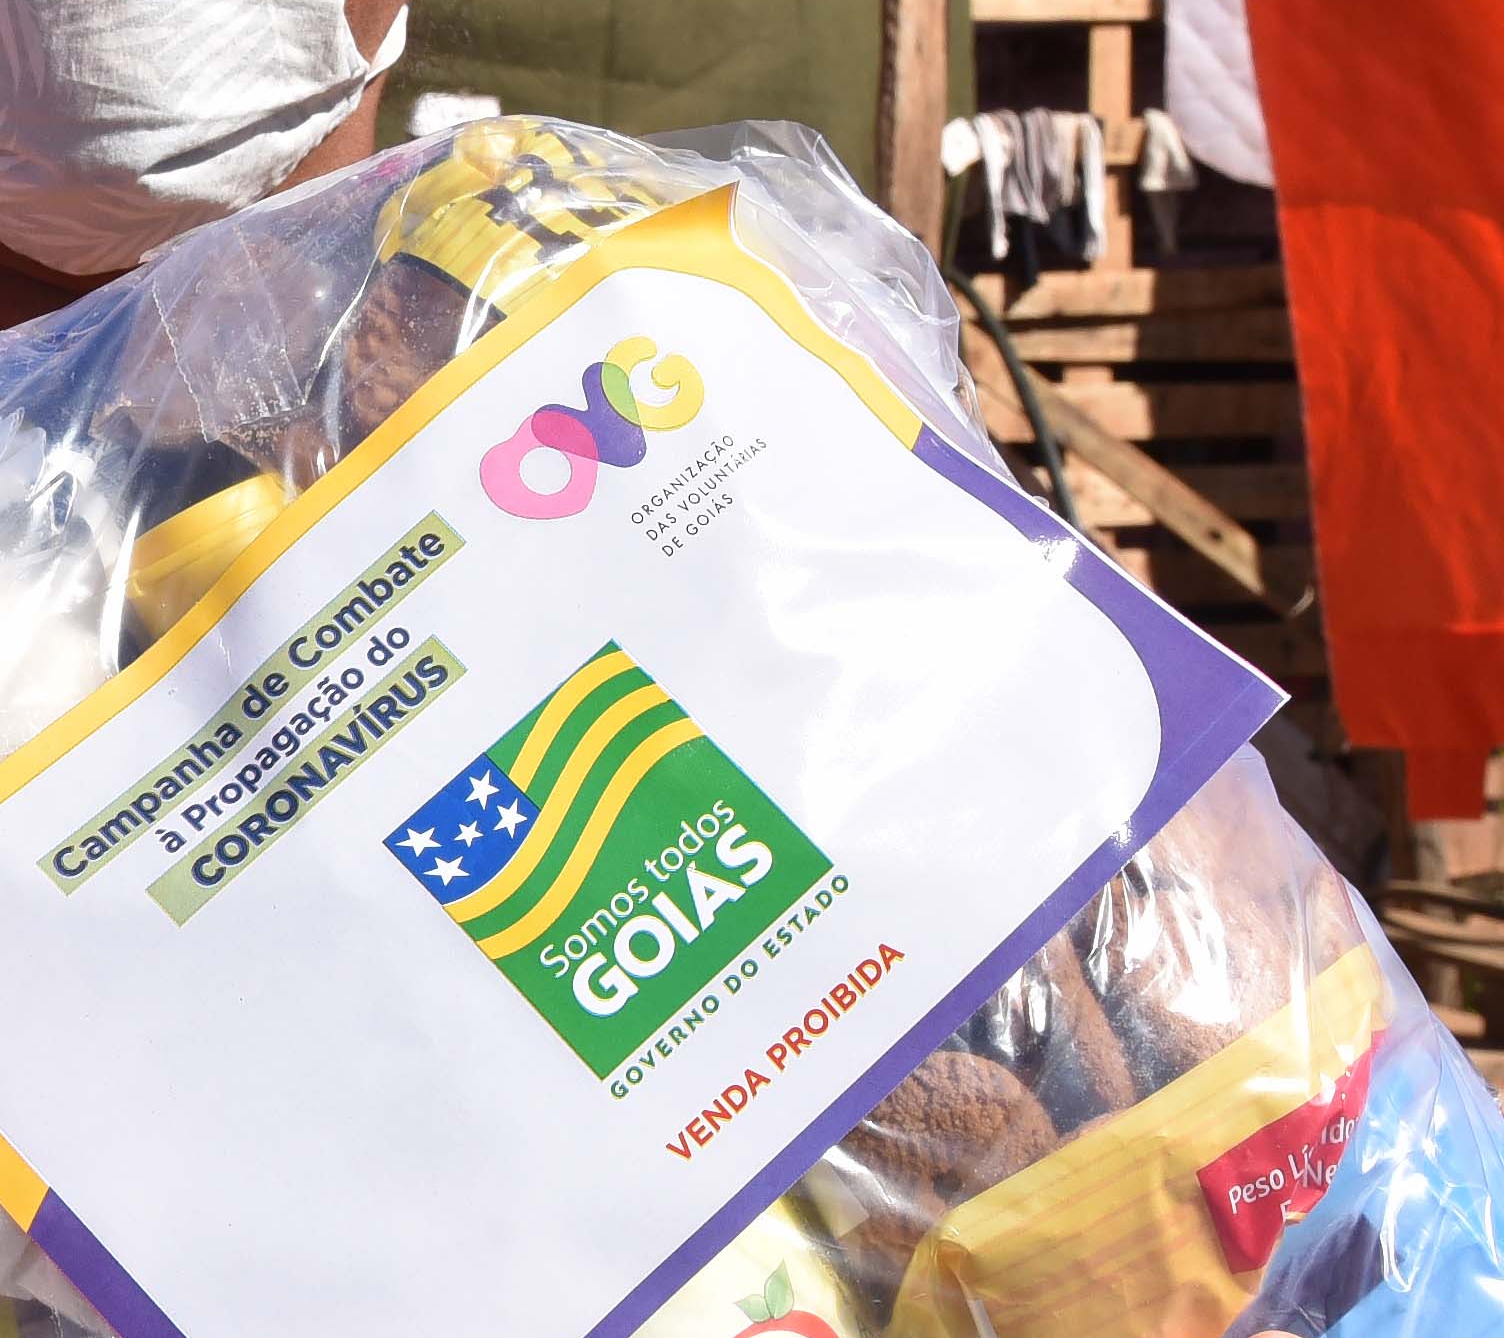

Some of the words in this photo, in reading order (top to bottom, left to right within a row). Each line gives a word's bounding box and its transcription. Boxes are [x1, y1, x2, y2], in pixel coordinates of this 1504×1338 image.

[479, 336, 705, 520] OVG
[631, 435, 734, 524] ORGANIZAÇÃO
[645, 512, 677, 541] DAS
[677, 438, 767, 512] VOLUNTÁRIAS
[661, 536, 684, 557] DE
[685, 493, 733, 536] GOIÁS
[52, 717, 243, 878] Campanha
[240, 668, 290, 721] de
[288, 530, 446, 670] Combate
[154, 827, 186, 854] à
[181, 665, 365, 833] Propagação
[365, 624, 411, 667] do
[191, 654, 450, 887] CORONAVÍRUS
[539, 876, 650, 980] Somos
[644, 797, 736, 885] todos
[571, 822, 774, 1019] GOIÁS
[609, 993, 721, 1100] GOVERNO
[723, 958, 760, 997] DO
[761, 873, 850, 960] ESTADO
[665, 1066, 772, 1162] VENDA
[765, 942, 906, 1072] PROIBIDA
[1228, 1168, 1286, 1215] Peso
